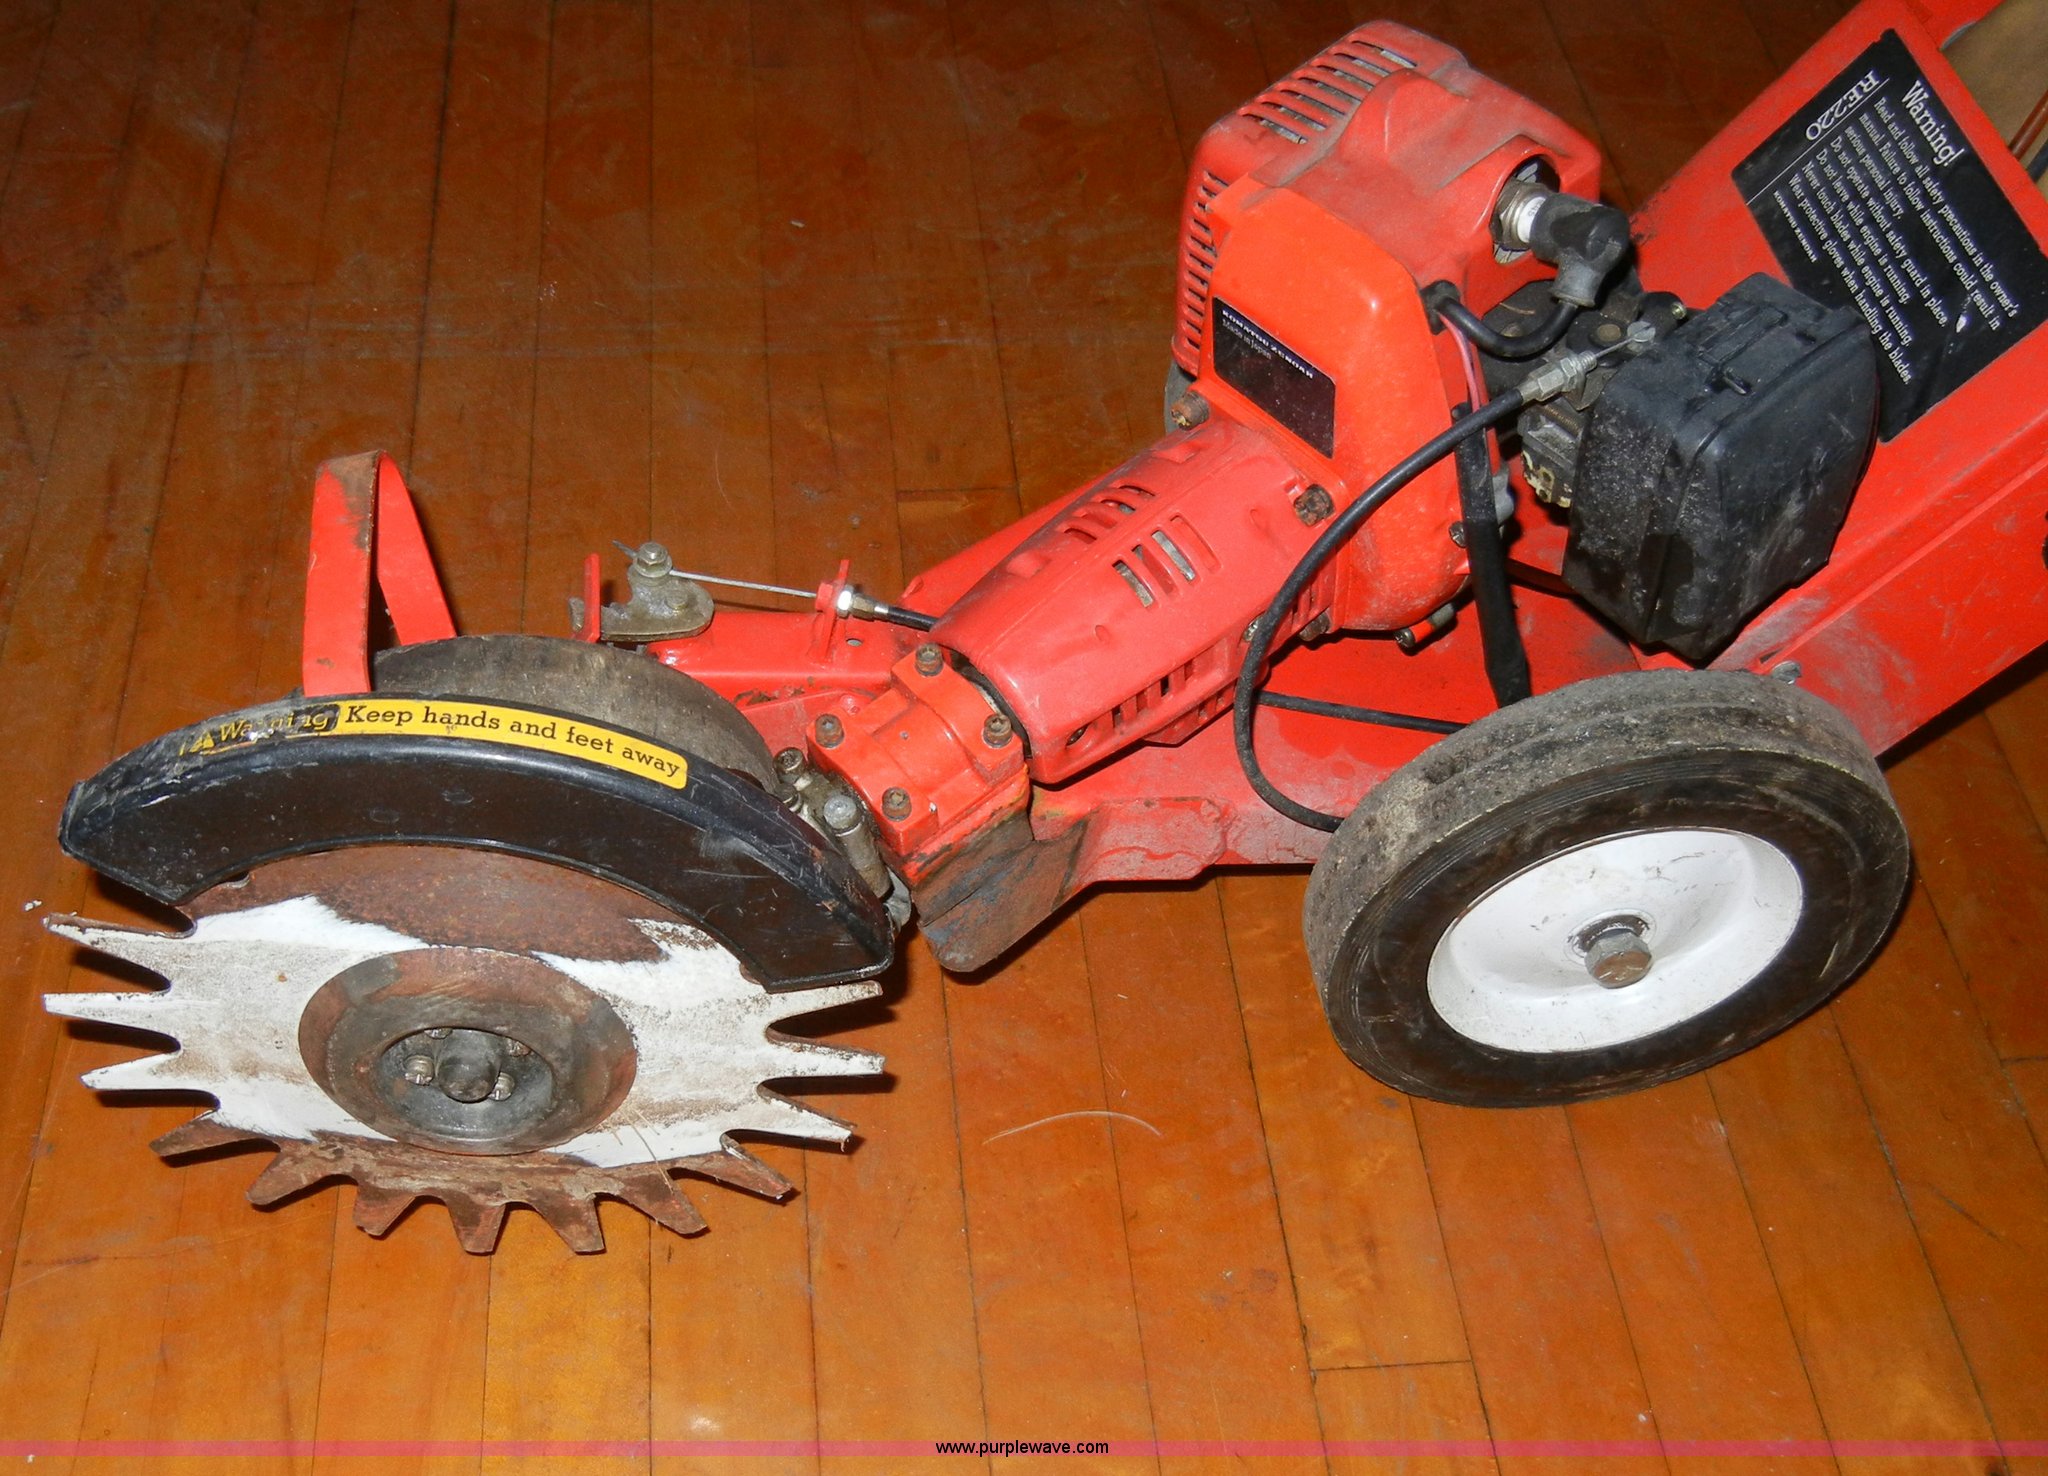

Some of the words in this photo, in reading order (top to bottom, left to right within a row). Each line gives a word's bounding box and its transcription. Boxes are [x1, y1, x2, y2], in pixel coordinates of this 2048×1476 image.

[1805, 70, 1880, 140] RE220
[1873, 96, 1896, 124] Read
[1887, 121, 1906, 141] and
[1901, 79, 1966, 167] Warning!
[1830, 135, 1843, 153] Do
[1837, 150, 1853, 168] not
[1898, 135, 1920, 165] follow
[1844, 125, 1867, 156] serious
[1859, 153, 1891, 191] personal
[1882, 186, 1905, 220] injury.
[1846, 166, 1870, 199] operate
[1914, 164, 1931, 179] all
[1922, 176, 1945, 205] safety
[1815, 148, 1828, 165] Do
[1823, 163, 1838, 181] not
[1831, 175, 1850, 203] leave
[1846, 200, 1865, 226] while
[1859, 225, 1883, 257] engine
[1877, 253, 1889, 266] is
[1883, 264, 1911, 305] running.
[1858, 112, 1886, 147] manual.
[1878, 141, 1901, 175] Failure
[1896, 171, 1908, 185] to
[1902, 181, 1925, 211] follow
[1919, 208, 1958, 264] instructions
[1952, 262, 1979, 291] could
[1970, 288, 1995, 319] result
[1988, 315, 2001, 331] in
[1866, 197, 1892, 232] without
[1937, 204, 1978, 256] precautions
[1801, 160, 1821, 190] Never
[1816, 186, 1837, 215] touch
[1830, 209, 1852, 242] blades
[1847, 239, 1866, 266] while
[1861, 265, 1884, 298] engine
[1879, 294, 1891, 308] is
[1885, 305, 1913, 347] running.
[1885, 230, 1908, 259] safety
[1971, 252, 1984, 267] in
[1788, 173, 1805, 200] Wear
[1797, 197, 1829, 241] protective
[1821, 239, 1845, 269] gloves
[1840, 266, 1859, 294] when
[1854, 288, 1883, 335] handling
[1878, 330, 1893, 351] the
[1888, 346, 1912, 385] blades.
[1900, 258, 1928, 288] guard
[1979, 262, 1994, 282] the
[1919, 283, 1932, 299] in
[1989, 281, 2020, 318] owner's
[1924, 296, 1948, 328] place.
[219, 711, 330, 743] Waning
[345, 705, 413, 728] Keep
[422, 706, 500, 730] hands
[510, 720, 557, 740] and
[567, 729, 614, 754] feet
[622, 745, 681, 778] away
